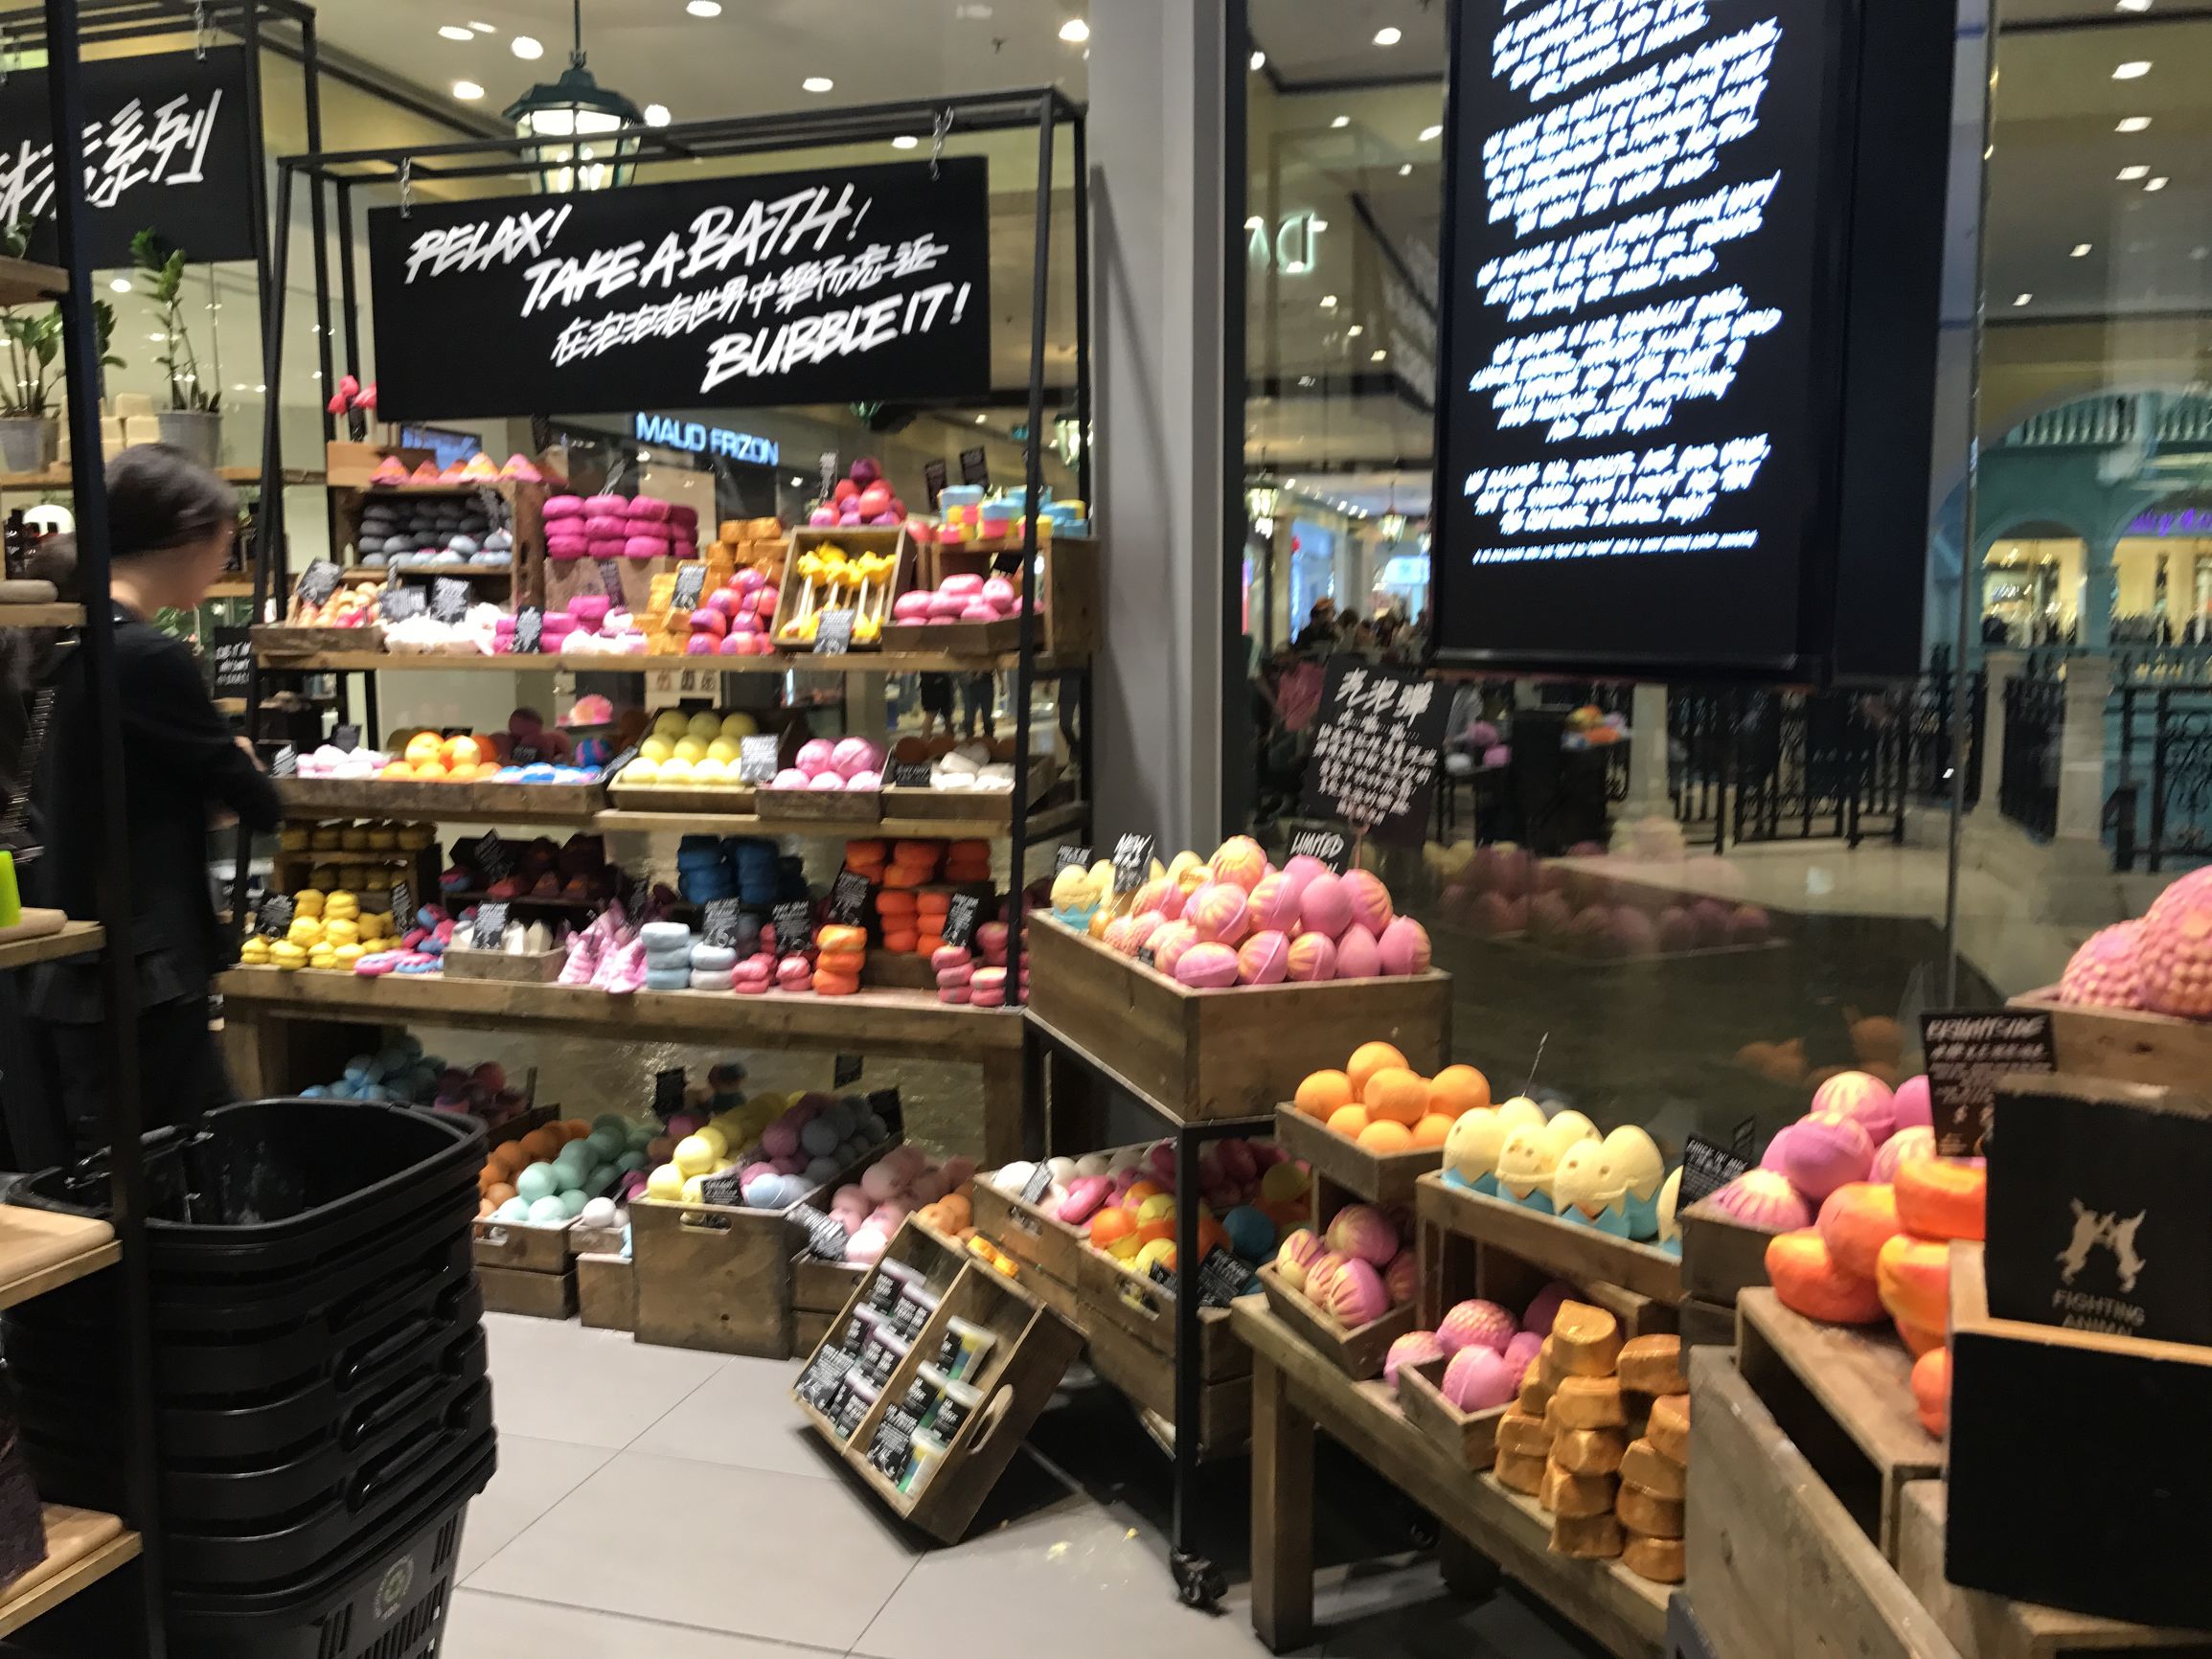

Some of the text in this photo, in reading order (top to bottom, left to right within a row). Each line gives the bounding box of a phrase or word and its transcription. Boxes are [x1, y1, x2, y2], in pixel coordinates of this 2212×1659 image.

[405, 203, 572, 283] RELAX!
[520, 183, 872, 317] TAKE A BATH!
[700, 283, 970, 394] BUBBLE IT!
[635, 411, 779, 466] MAUD FRIZON
[1289, 831, 1345, 859] LIMITED
[2052, 1289, 2145, 1328] FIGHTING
